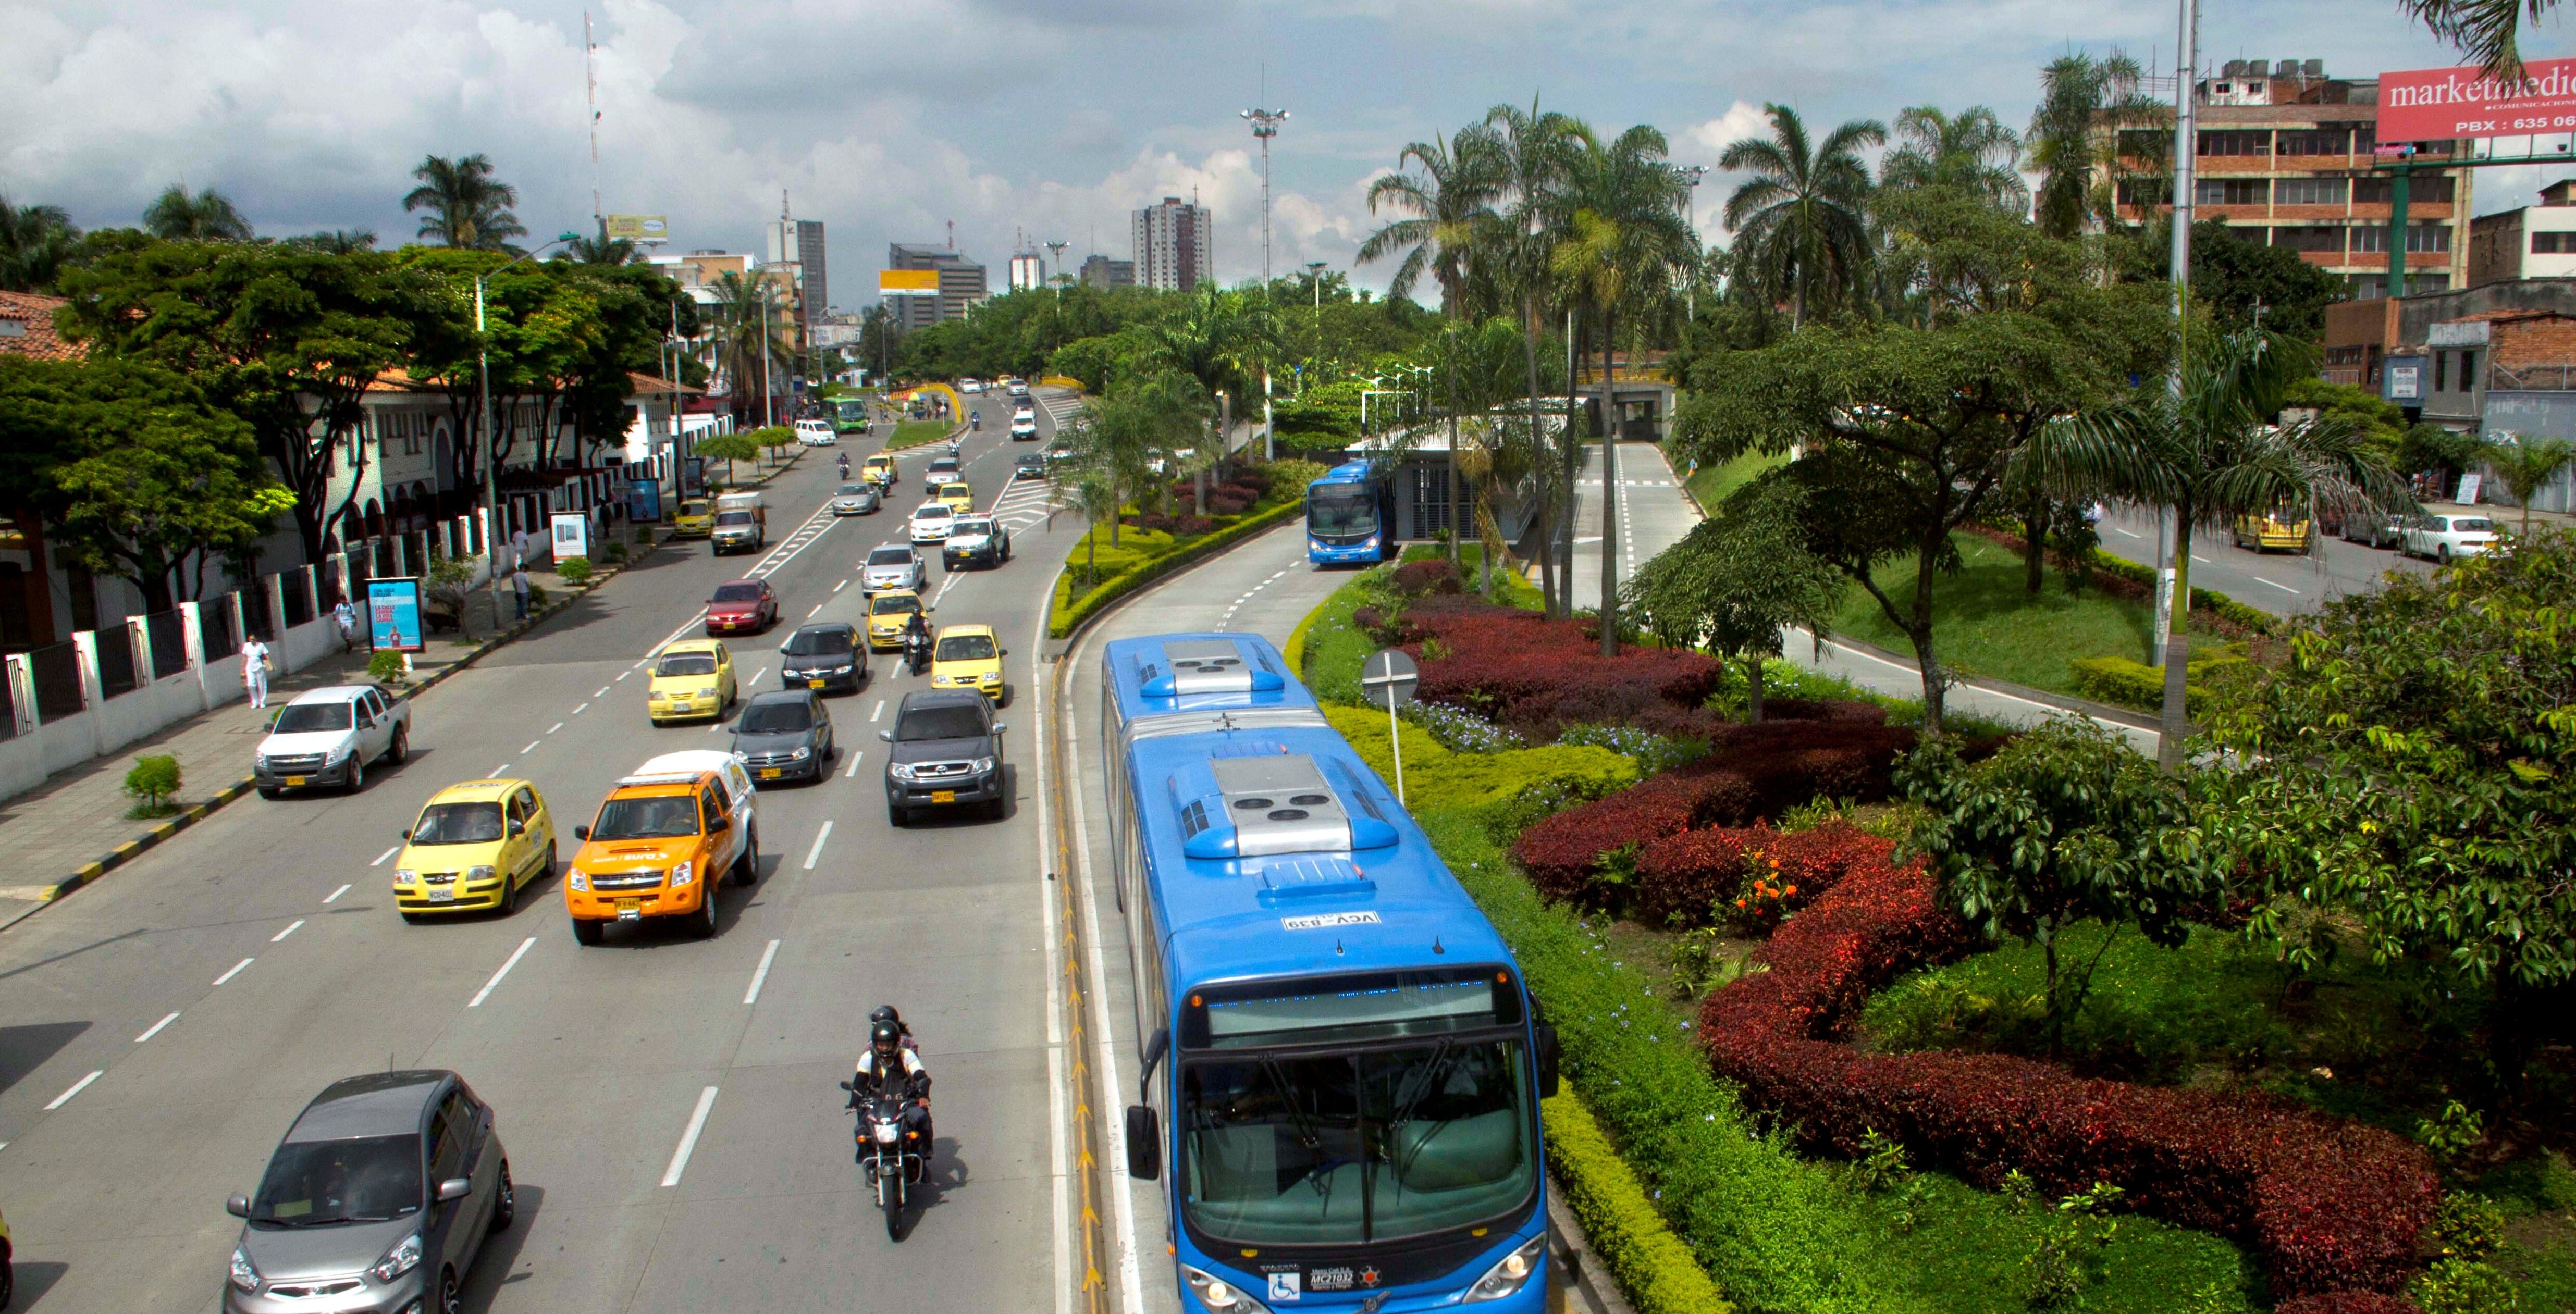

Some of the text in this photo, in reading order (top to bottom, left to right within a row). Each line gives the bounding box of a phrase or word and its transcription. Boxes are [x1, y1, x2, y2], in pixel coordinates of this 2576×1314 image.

[2455, 120, 2496, 132] PBX
[2513, 117, 2547, 129] 635
[1311, 1273, 1353, 1284] MC21032
